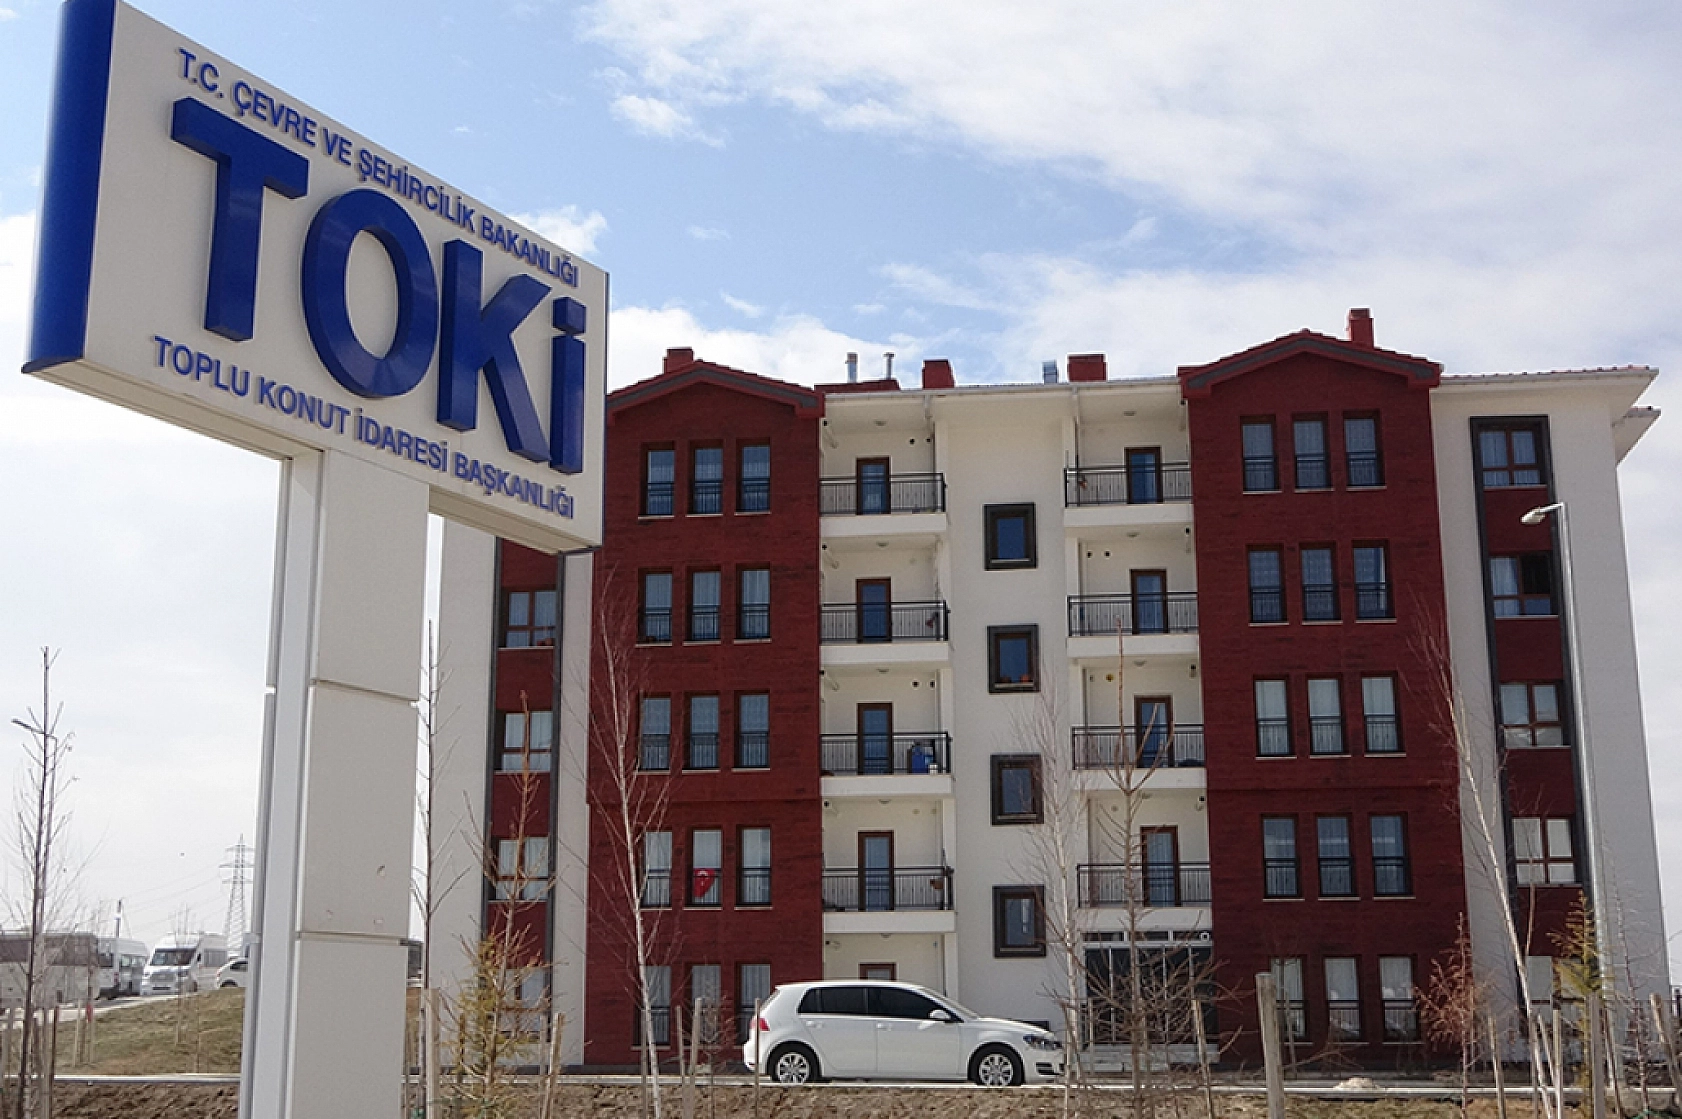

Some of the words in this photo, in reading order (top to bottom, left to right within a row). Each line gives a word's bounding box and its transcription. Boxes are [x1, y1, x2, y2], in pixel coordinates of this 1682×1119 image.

[178, 47, 224, 100] T.C.
[233, 80, 316, 147] ÇEVRE
[322, 128, 353, 167] VE
[357, 149, 476, 234] ŞEHİRCİLİK
[481, 216, 579, 287] BAKANLIĞI
[154, 336, 250, 397] TOPLU
[258, 377, 351, 434] KONUT
[355, 408, 448, 471] İDARESİ
[454, 451, 575, 519] BAŞKANLIĞI
